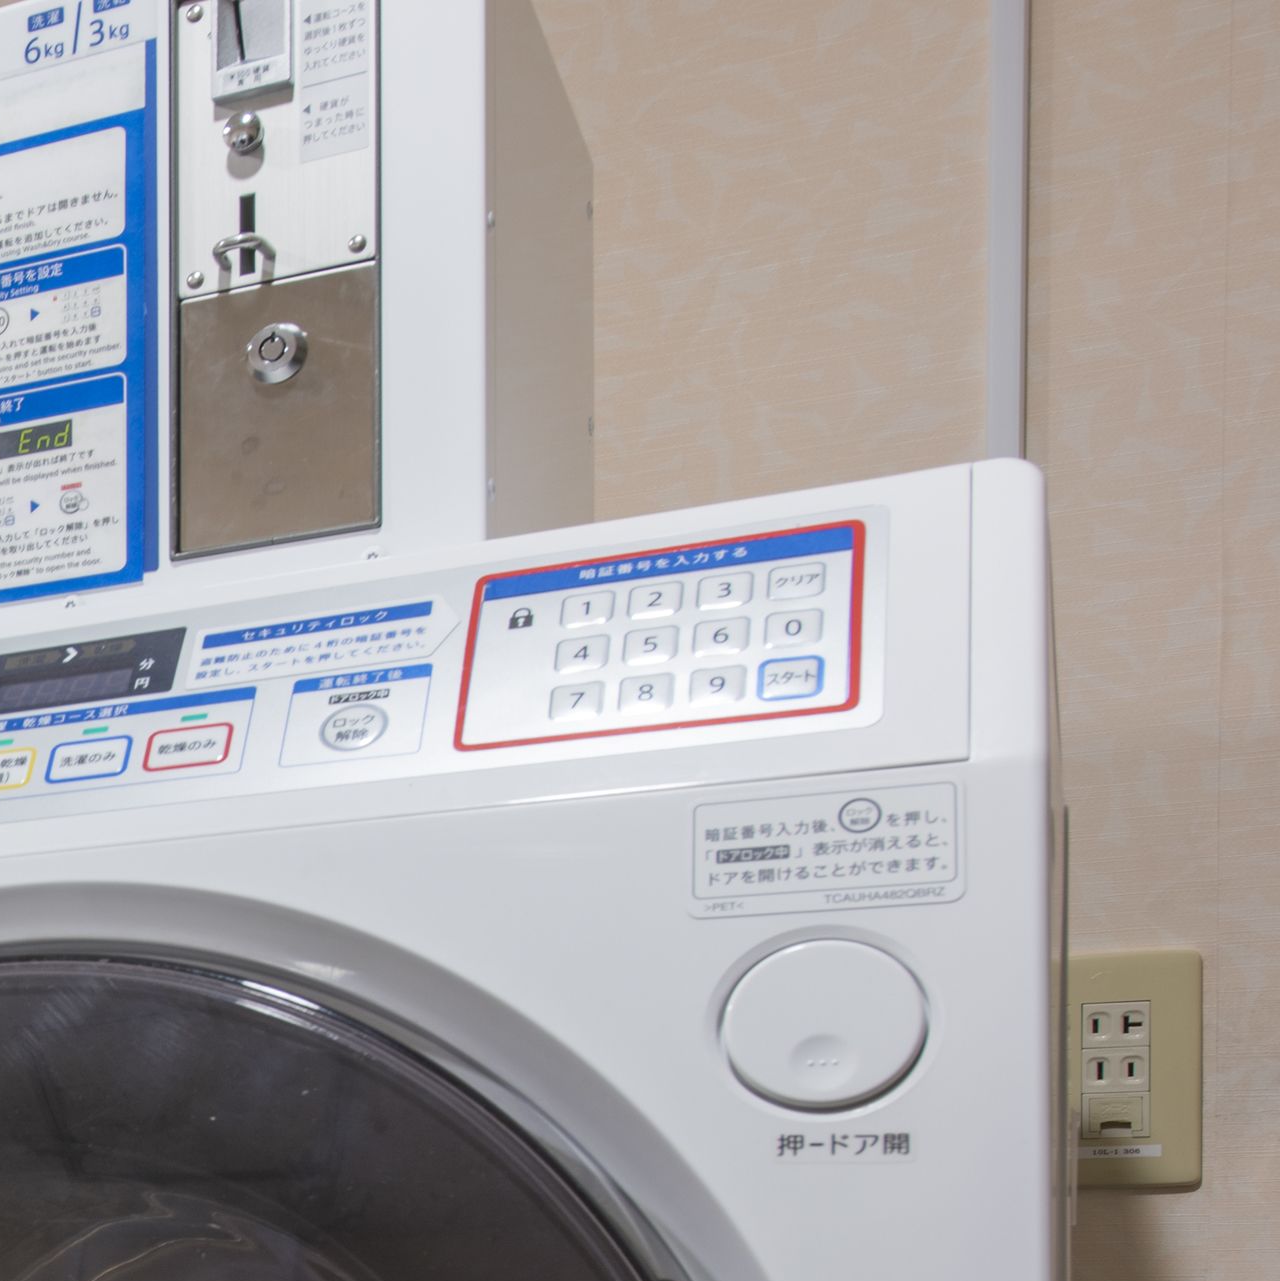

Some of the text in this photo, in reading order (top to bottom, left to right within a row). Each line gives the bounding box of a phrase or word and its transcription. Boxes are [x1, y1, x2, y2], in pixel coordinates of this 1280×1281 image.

[30, 8, 61, 31] 洗濯
[24, 36, 65, 66] 6kg
[89, 18, 130, 47] 3kg
[304, 33, 366, 57] ゆっくり硬貨を
[303, 49, 366, 73] 入れてください
[319, 95, 349, 111] 硬貨が
[304, 107, 365, 130] つまった時に
[303, 122, 365, 145] 押してください
[10, 284, 39, 299] Setting
[14, 361, 29, 370] and
[43, 356, 55, 365] the
[56, 349, 88, 363] security
[18, 424, 71, 455] End
[579, 545, 750, 581] 暗証番号を入力する
[774, 572, 821, 589] クリア
[717, 582, 732, 598] 3
[581, 600, 591, 615] 1
[648, 591, 663, 608] 2
[242, 610, 389, 642] セキュリティロック
[785, 618, 802, 636] 0
[643, 636, 658, 652] 5
[713, 627, 729, 644] 6
[200, 626, 428, 667] 盗難防止のために4桁の暗証番号を
[573, 644, 589, 661] 4
[138, 658, 156, 672] 分
[134, 677, 150, 689] 円
[319, 669, 404, 689] 運転終了後
[709, 676, 725, 693] 9
[766, 669, 817, 687] スタート
[330, 689, 390, 704] ドアロック中
[638, 683, 655, 701] 8
[569, 692, 585, 710] 7
[332, 714, 376, 728] ロック
[334, 728, 369, 742] 解除
[157, 738, 217, 755] 乾燥のみ
[59, 751, 116, 768] 洗濯のみ
[845, 807, 874, 817] ロック
[708, 856, 948, 888] ドアを開けることができます。
